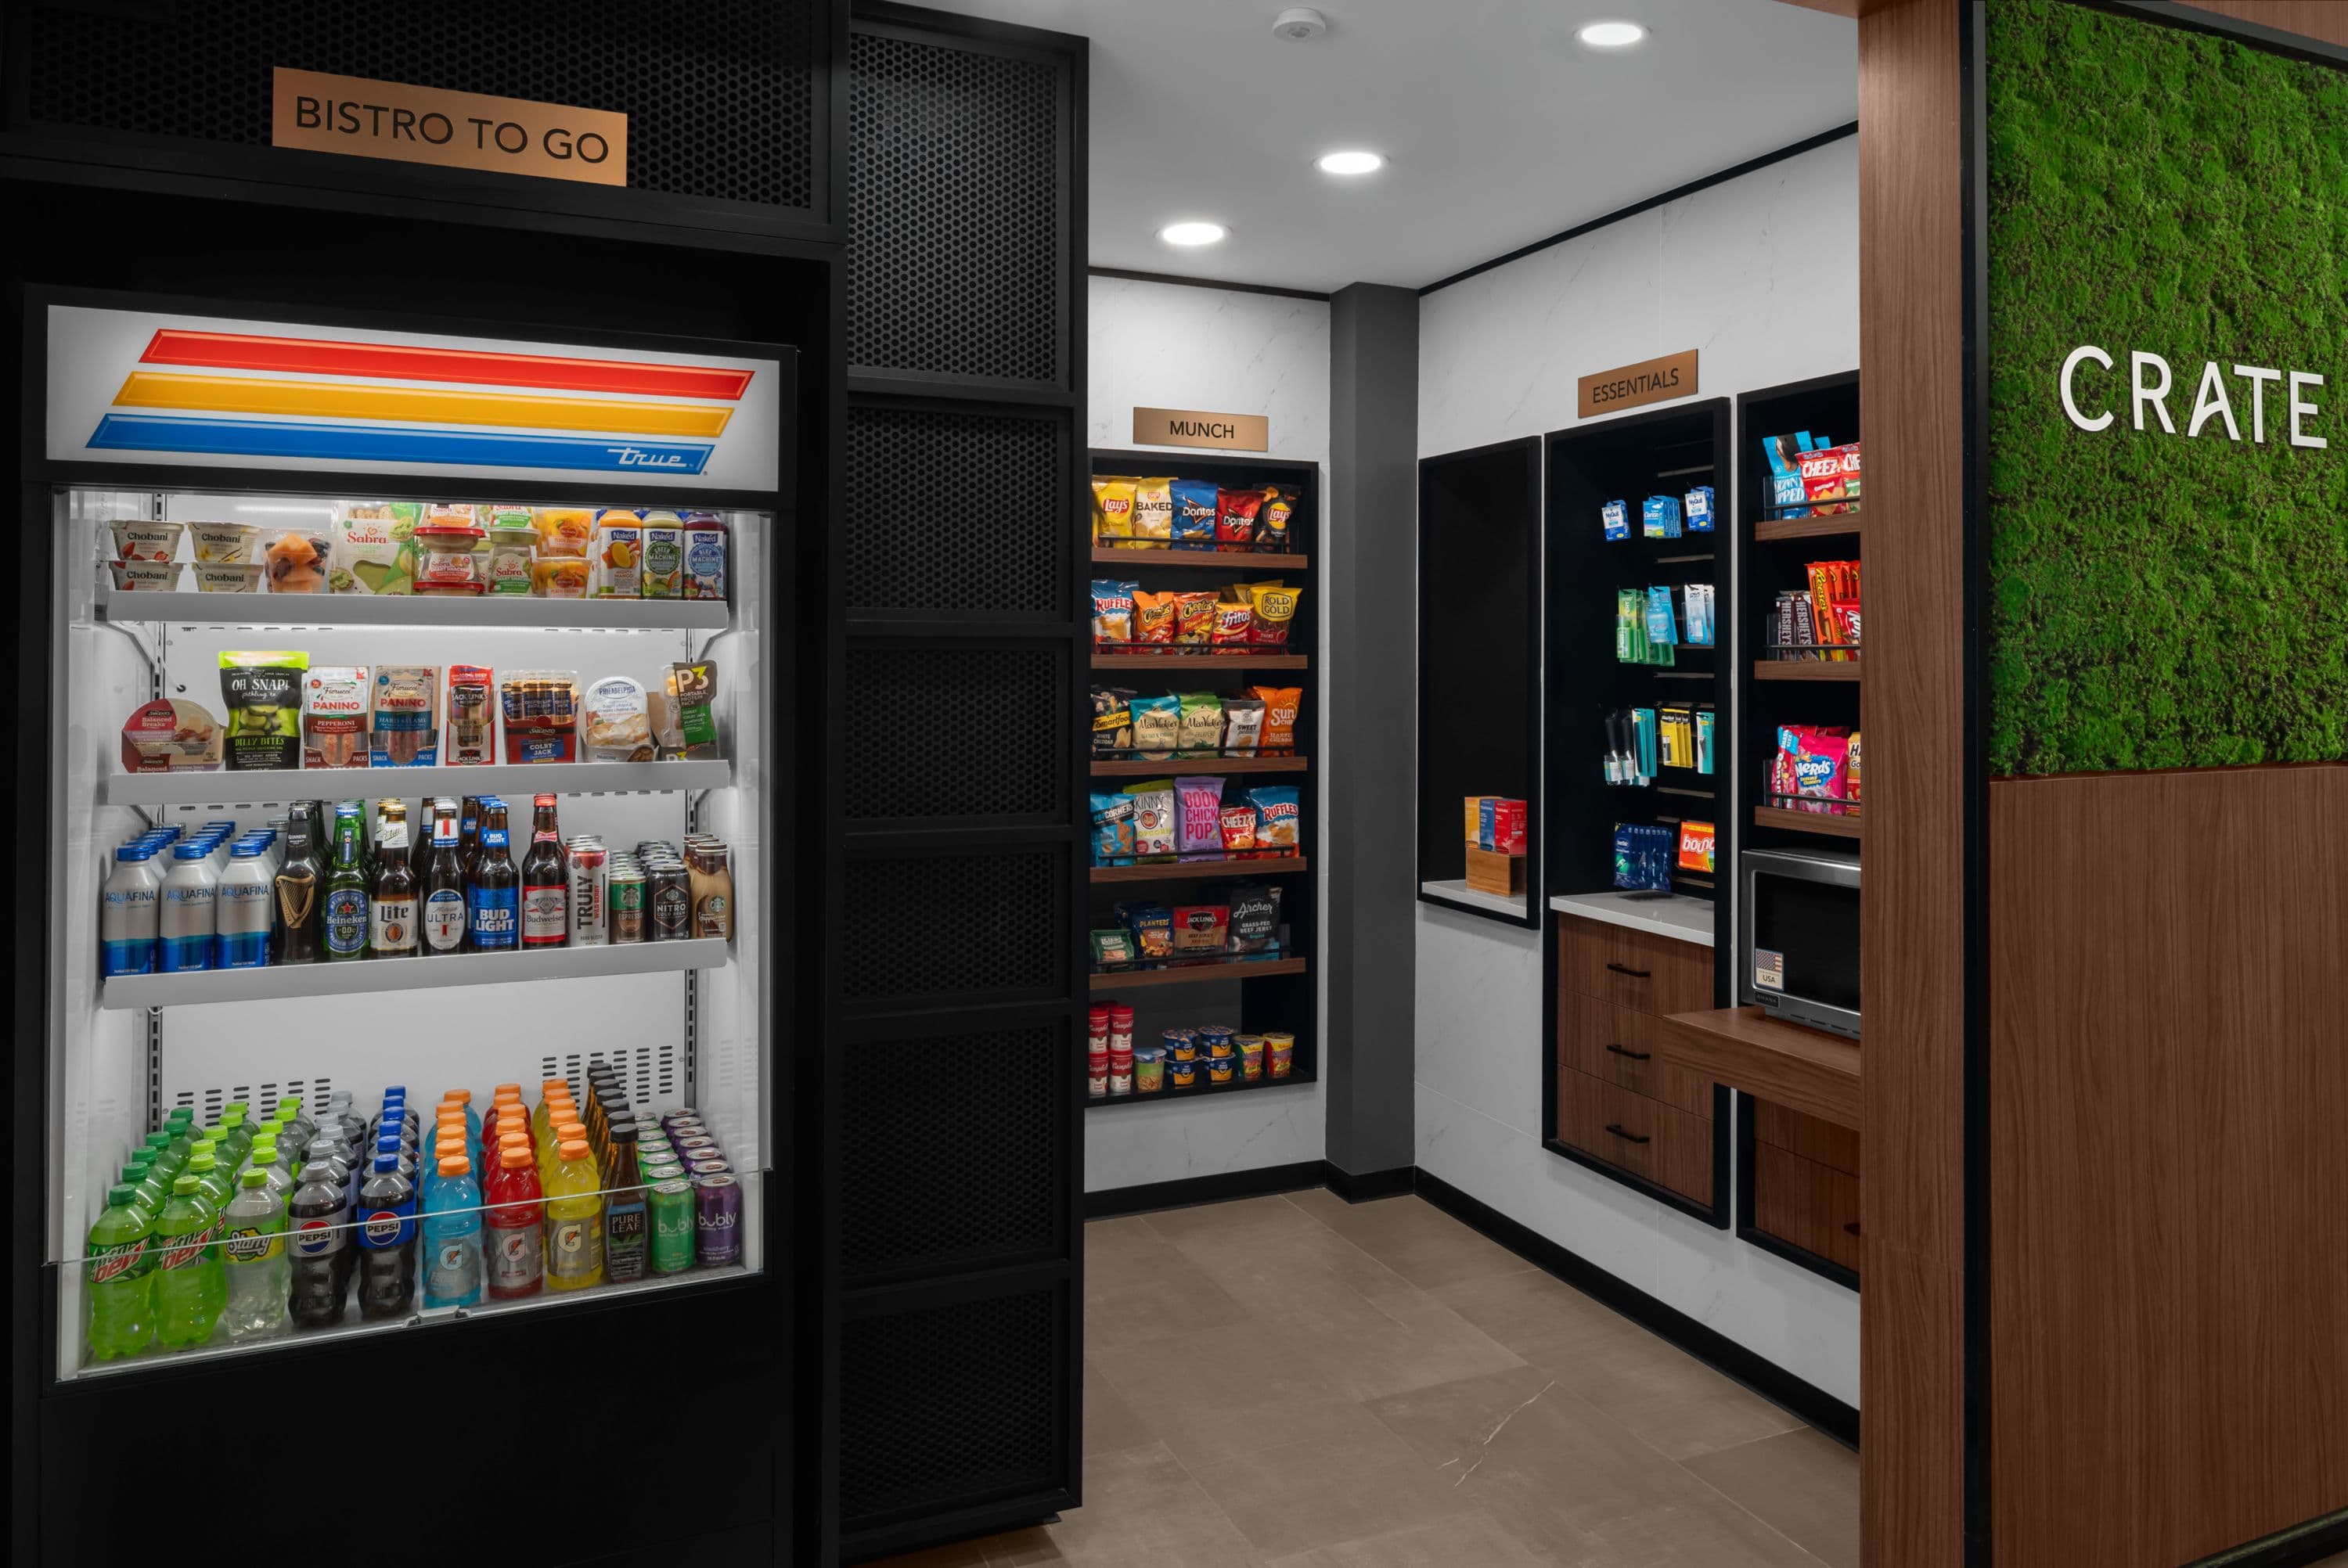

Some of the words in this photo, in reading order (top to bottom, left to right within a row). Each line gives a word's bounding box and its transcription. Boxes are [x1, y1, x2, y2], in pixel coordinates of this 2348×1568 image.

[297, 95, 453, 145] BISTRO
[468, 117, 528, 153] TO
[543, 128, 609, 164] GO
[1593, 368, 1679, 404] ESSENTIALS
[2060, 346, 2327, 448] CRATE
[1170, 421, 1233, 438] MUNCH
[1136, 502, 1172, 511] BAKED
[1183, 506, 1215, 517] Doritos
[1223, 516, 1254, 525] Doritos
[128, 532, 167, 541] Chobani
[201, 534, 240, 543] Chobani
[348, 531, 387, 544] Sabra
[127, 571, 167, 581] Chobani
[205, 573, 244, 582] Chobani
[496, 567, 522, 576] Sabra
[1096, 598, 1133, 613] RUFFLES
[1265, 595, 1289, 606] ROLD
[1183, 601, 1212, 618] Cheetos
[1264, 605, 1289, 614] GOLD
[1222, 611, 1251, 628] Fritos
[232, 678, 247, 691] OH
[252, 678, 290, 691] SNAP!
[323, 686, 351, 695] Fiorucci
[599, 686, 636, 695] PHILADELPHIA
[380, 699, 426, 707] PANINO
[1096, 714, 1128, 728] Smartfoo
[1188, 717, 1202, 727] Miss
[1271, 708, 1295, 726] Sun
[1140, 719, 1154, 728] Miss
[261, 737, 284, 746] BITES
[1795, 761, 1830, 776] Nerds
[1134, 797, 1164, 810] KINNY
[1183, 791, 1219, 808] BOOM
[1186, 808, 1216, 822] CHICK
[1264, 804, 1298, 821] RUFFLES
[1186, 823, 1212, 840] POP
[106, 890, 154, 904] AQUAFINA
[167, 887, 215, 901] AQUAFINA
[221, 885, 269, 897] AQUAFINA
[578, 876, 592, 930] TRULY
[657, 903, 686, 912] NITRO
[380, 905, 409, 922] Lite
[480, 909, 510, 919] BUD
[1233, 902, 1273, 919] Archer
[427, 912, 463, 922] ULTRA
[1140, 919, 1170, 927] PLANTERS
[476, 919, 514, 931] LIGHT
[1763, 975, 1776, 984] USA
[612, 1214, 640, 1225] PURE
[658, 1216, 694, 1233] bubly
[699, 1211, 736, 1227] bubly
[367, 1223, 399, 1233] PEPSI
[612, 1223, 639, 1234] LEAF
[298, 1232, 331, 1242] PEPSI
[228, 1232, 272, 1255] Starry
